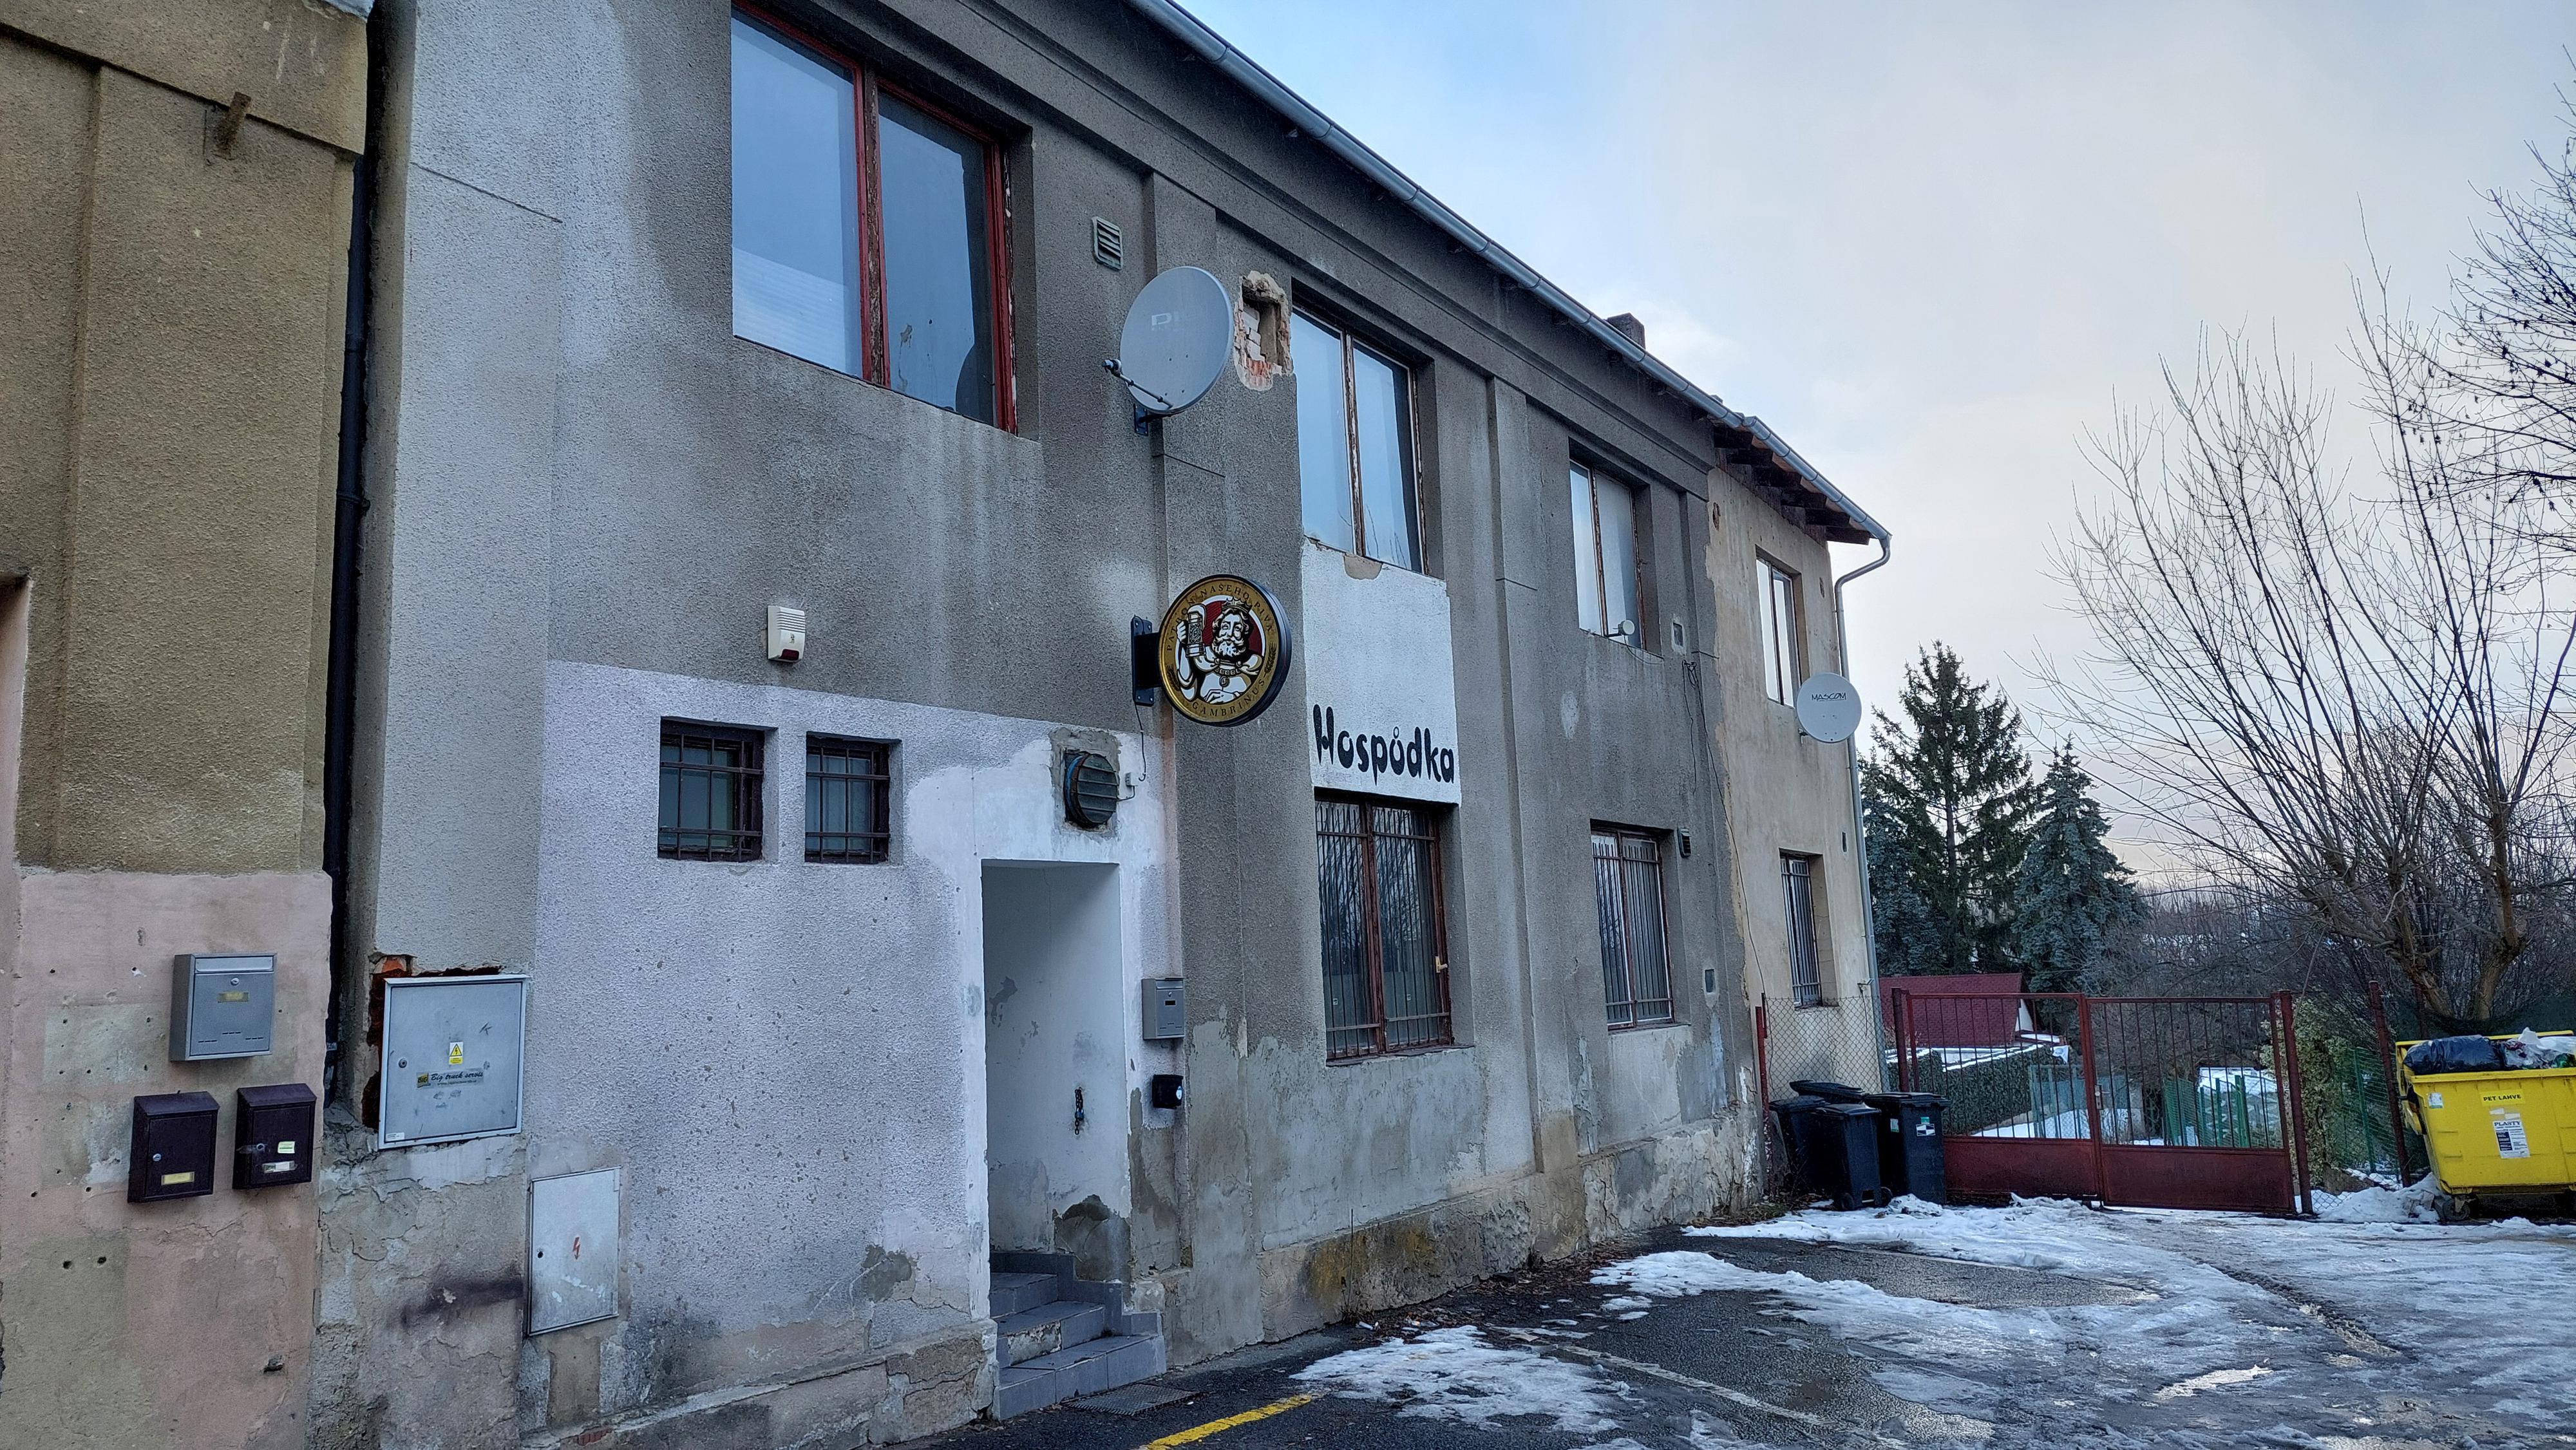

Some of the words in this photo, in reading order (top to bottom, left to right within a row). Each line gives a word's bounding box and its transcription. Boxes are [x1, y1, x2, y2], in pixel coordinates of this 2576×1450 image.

[1253, 601, 1273, 632] PIVA
[1192, 679, 1265, 717] GAMBRINUS
[1812, 692, 1847, 701] MASCOM
[1313, 704, 1454, 786] Hospůdka
[431, 1073, 443, 1082] Big
[445, 1071, 464, 1080] truck
